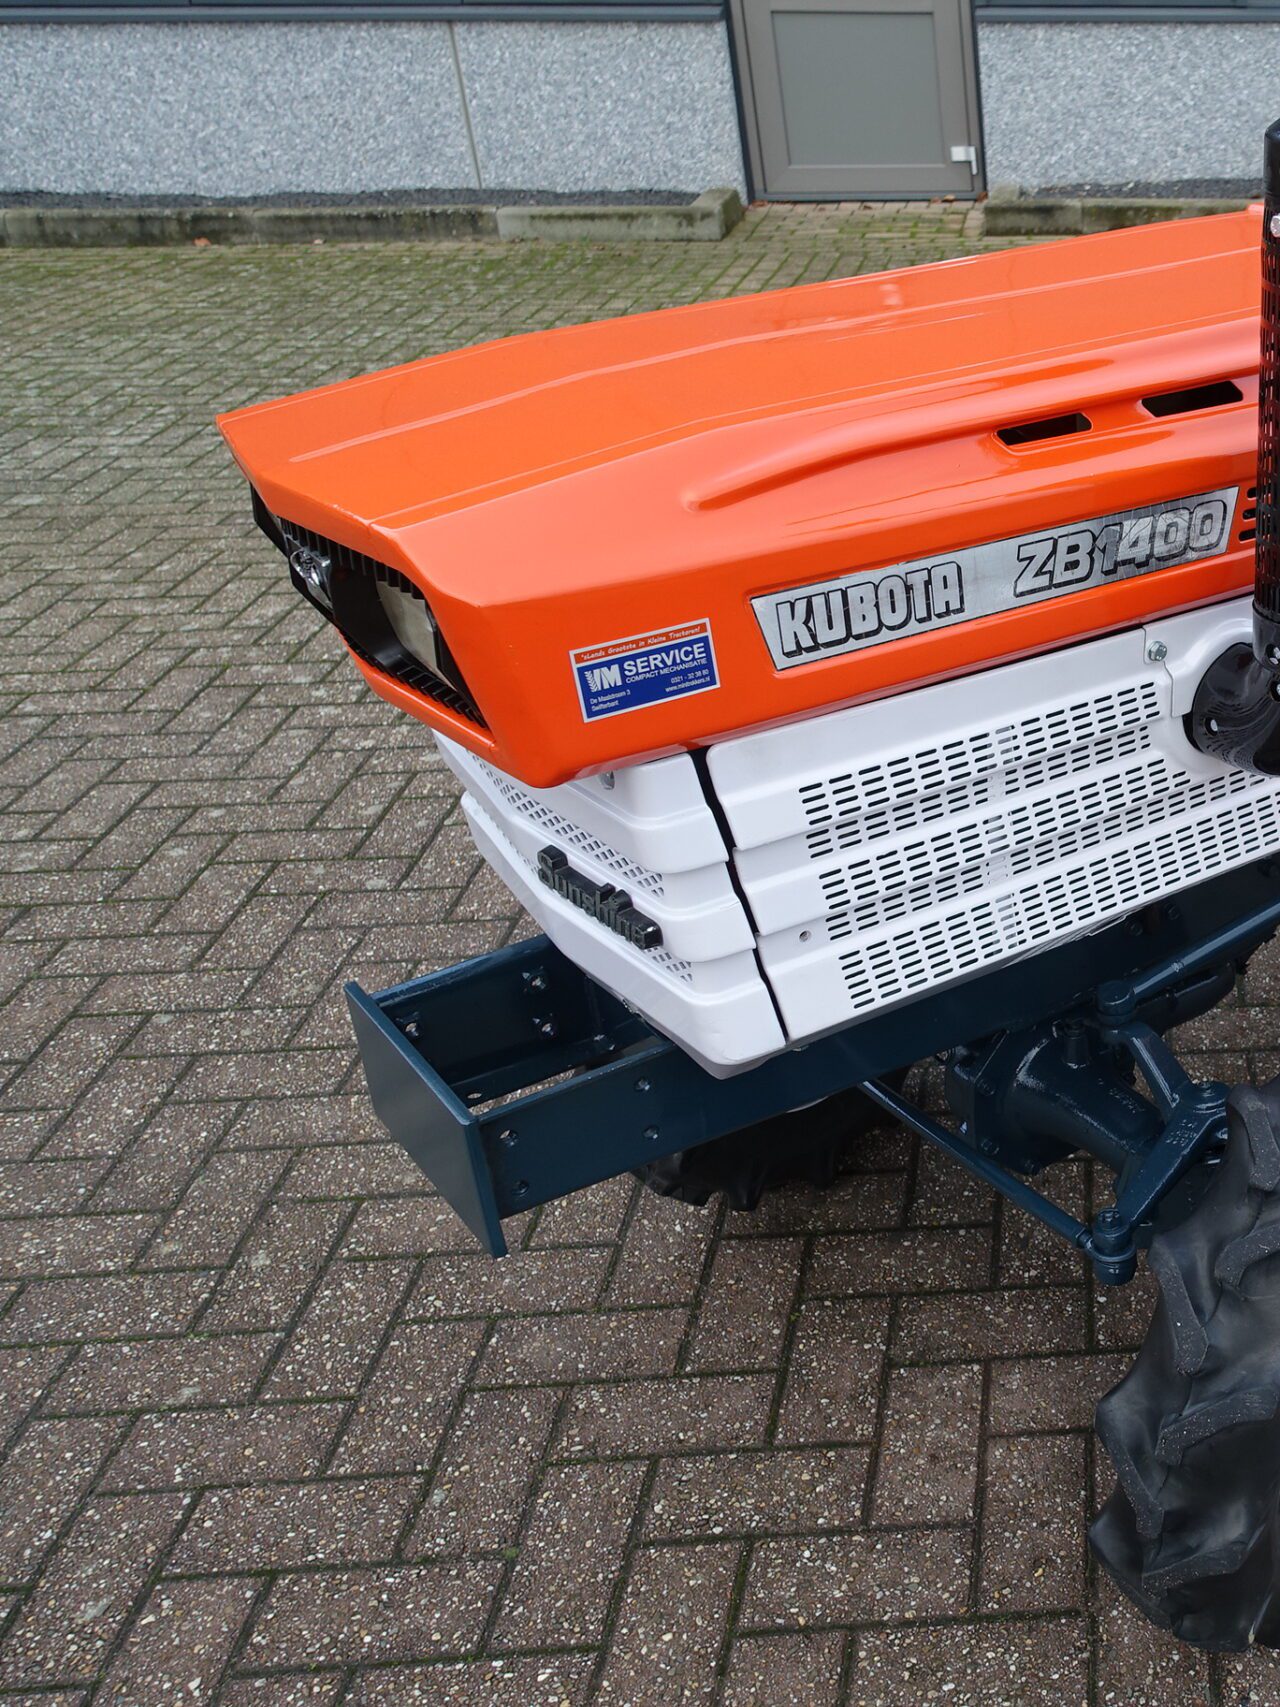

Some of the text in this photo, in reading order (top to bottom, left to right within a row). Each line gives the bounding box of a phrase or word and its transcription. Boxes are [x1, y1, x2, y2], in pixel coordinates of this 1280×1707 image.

[776, 499, 1227, 658] KUBOTA ZB1400
[623, 643, 706, 677] SERVICE
[625, 657, 708, 684] COMPACT MECHANISATIE
